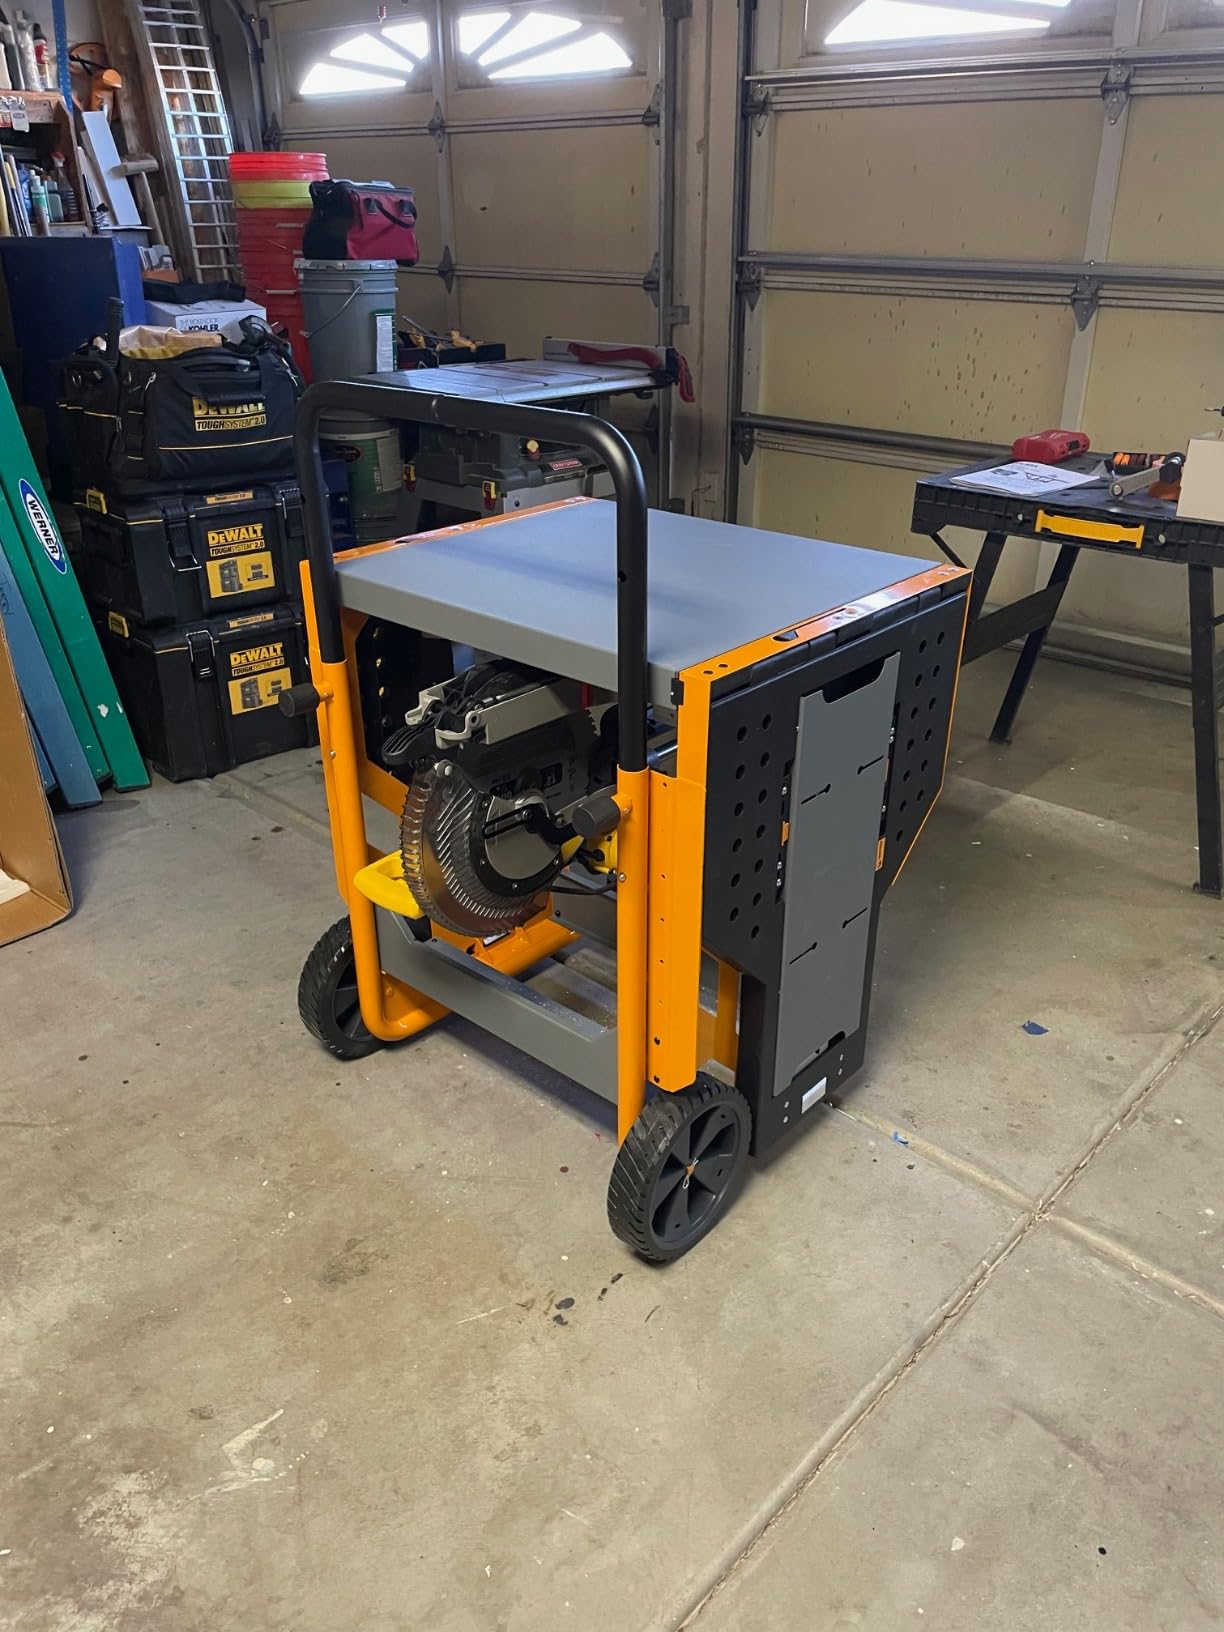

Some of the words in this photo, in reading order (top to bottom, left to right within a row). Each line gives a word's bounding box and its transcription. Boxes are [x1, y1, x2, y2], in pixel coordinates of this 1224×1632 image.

[188, 323, 220, 333] KOHLER
[254, 415, 265, 425] 2.0
[28, 499, 58, 554] WERNER
[254, 541, 264, 549] 2.0
